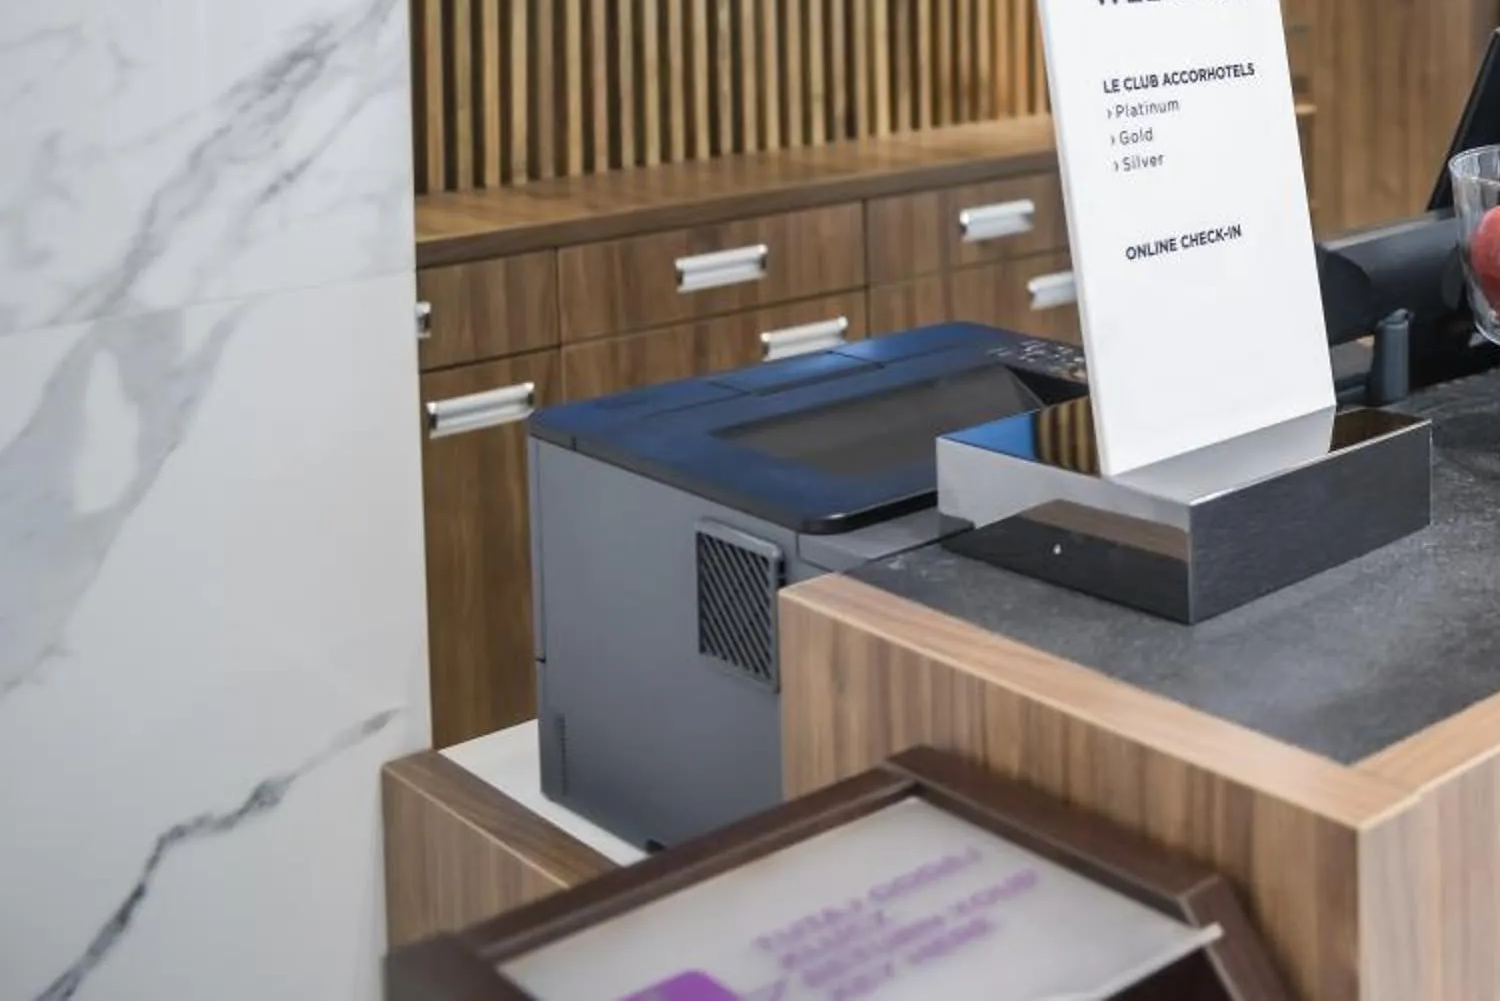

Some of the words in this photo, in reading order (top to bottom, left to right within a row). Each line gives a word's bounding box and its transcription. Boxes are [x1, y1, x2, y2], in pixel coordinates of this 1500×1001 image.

[1103, 78, 1121, 94] LE
[1123, 74, 1159, 92] CLUB
[1162, 62, 1255, 86] ACCORHOTELS
[1115, 99, 1180, 119] Platinum
[1119, 127, 1153, 146] Gold
[1122, 154, 1164, 172] Silver
[1125, 237, 1178, 260] ONLINE
[1180, 223, 1243, 249] CHECK-IN
